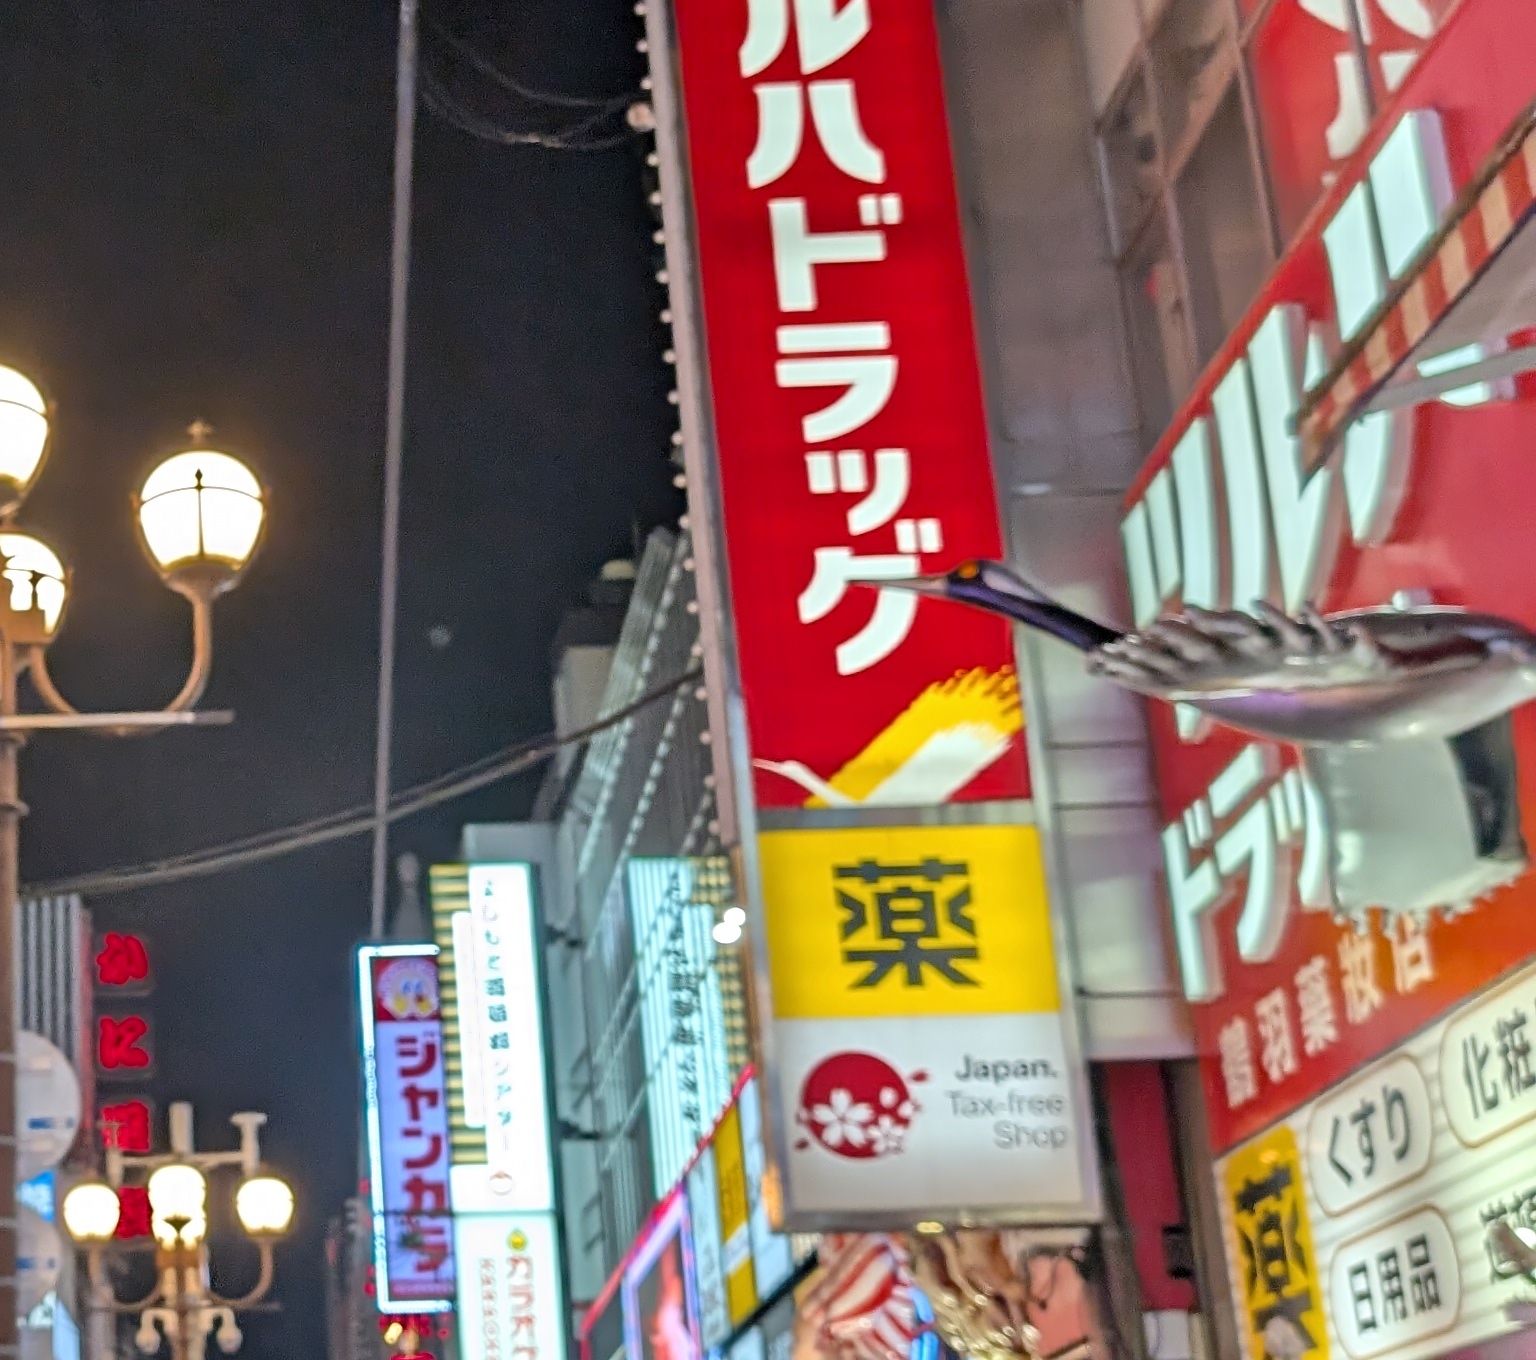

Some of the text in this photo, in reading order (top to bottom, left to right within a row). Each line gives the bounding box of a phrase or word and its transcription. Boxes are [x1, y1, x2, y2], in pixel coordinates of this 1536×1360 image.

[832, 857, 982, 990] 薬
[1161, 742, 1332, 1002] ドラッ
[948, 1087, 1064, 1117] Tax-free
[1462, 1008, 1536, 1122] 化粧
[395, 1031, 452, 1274] ジャンカラ
[993, 1117, 1066, 1151] Shop
[1328, 1084, 1412, 1190] くすり
[1348, 1232, 1443, 1337] 日用品
